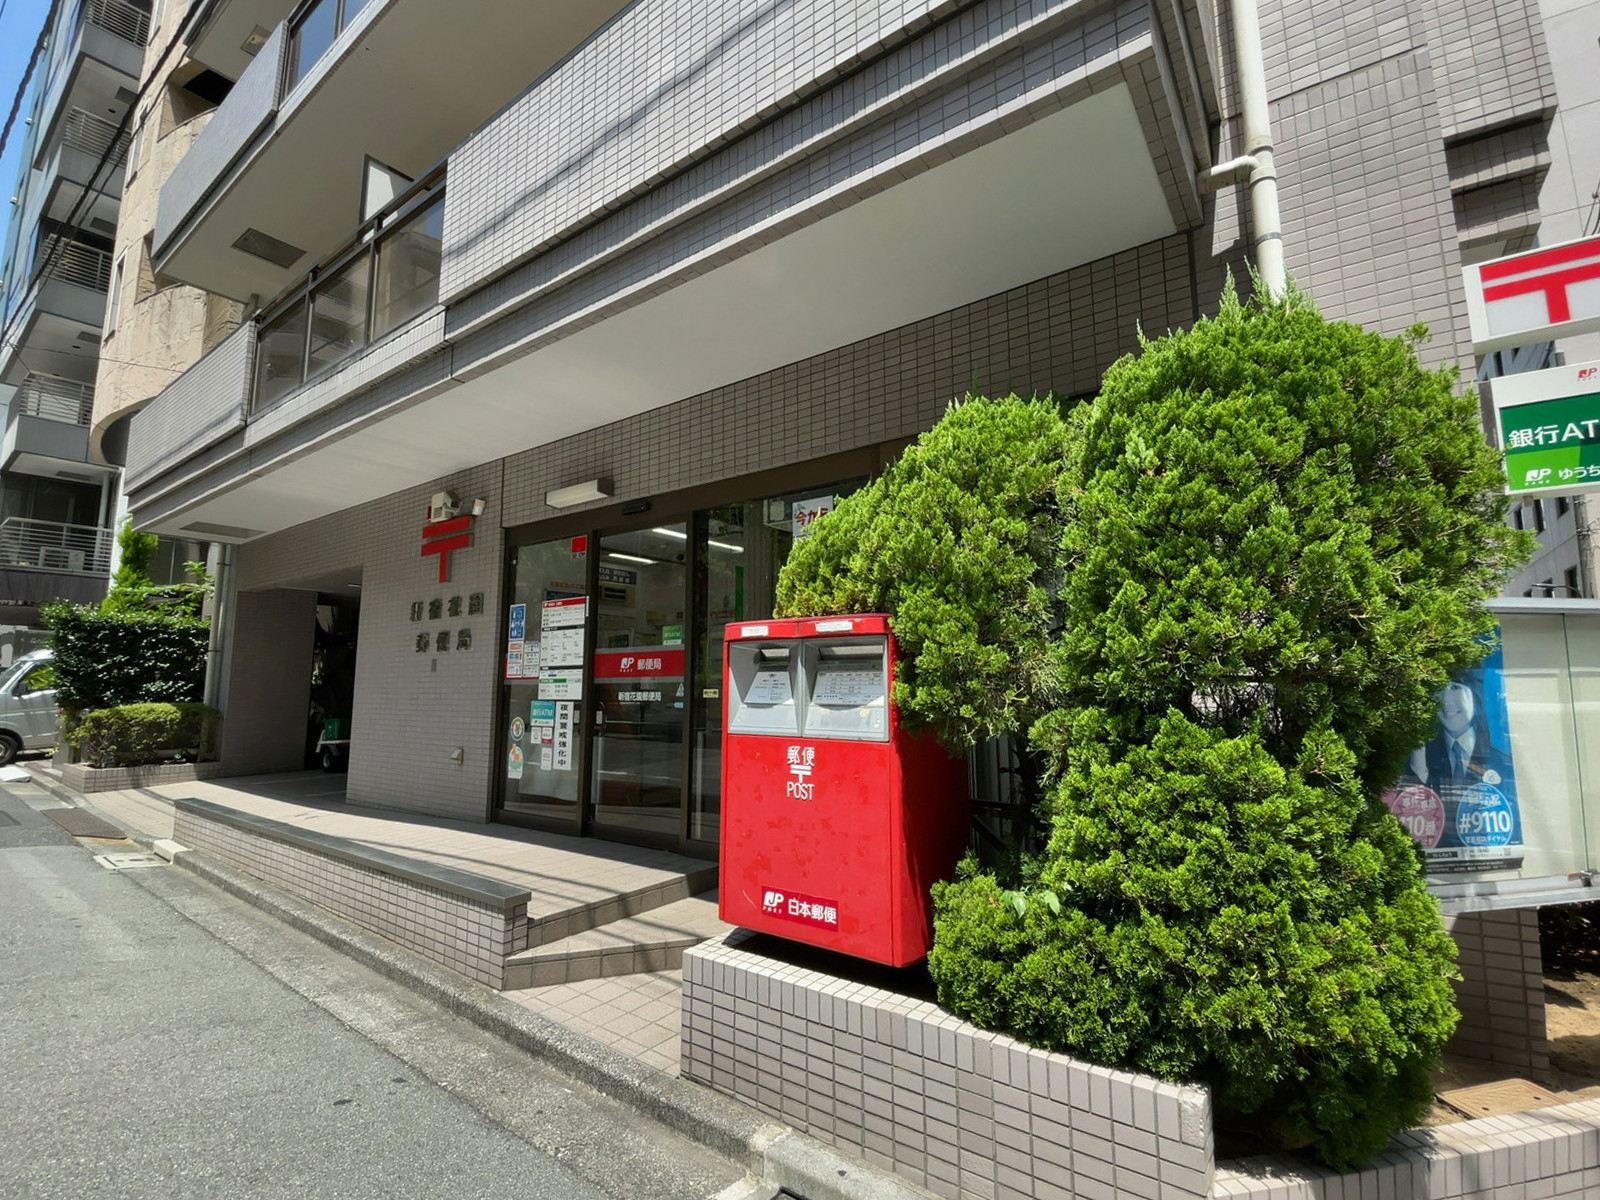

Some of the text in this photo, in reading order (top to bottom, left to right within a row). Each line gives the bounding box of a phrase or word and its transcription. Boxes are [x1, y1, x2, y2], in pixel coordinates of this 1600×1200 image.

[1558, 464, 1600, 479] ゆうち
[787, 746, 815, 766] 郵便
[787, 782, 814, 800] POST
[1459, 811, 1511, 834] #9110
[788, 898, 837, 924] 日本郵便
